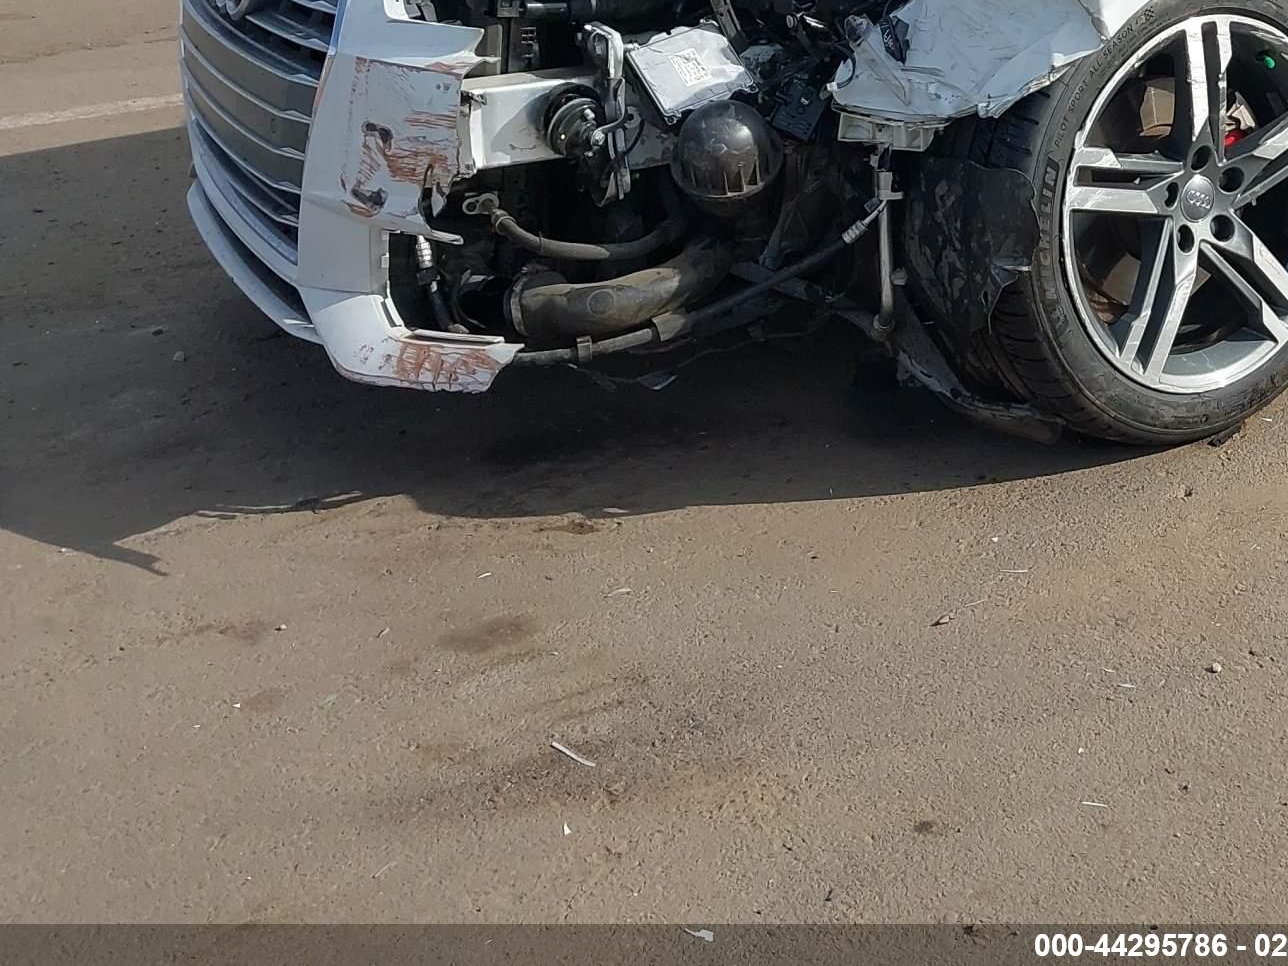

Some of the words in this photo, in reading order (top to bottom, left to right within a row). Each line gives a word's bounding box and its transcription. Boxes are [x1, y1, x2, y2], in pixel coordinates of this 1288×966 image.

[1054, 116, 1071, 147] PILOT
[1068, 79, 1089, 114] SPORT
[1088, 59, 1103, 80] ALL
[1102, 24, 1134, 59] SEASON
[1038, 166, 1058, 300] MICHELIN
